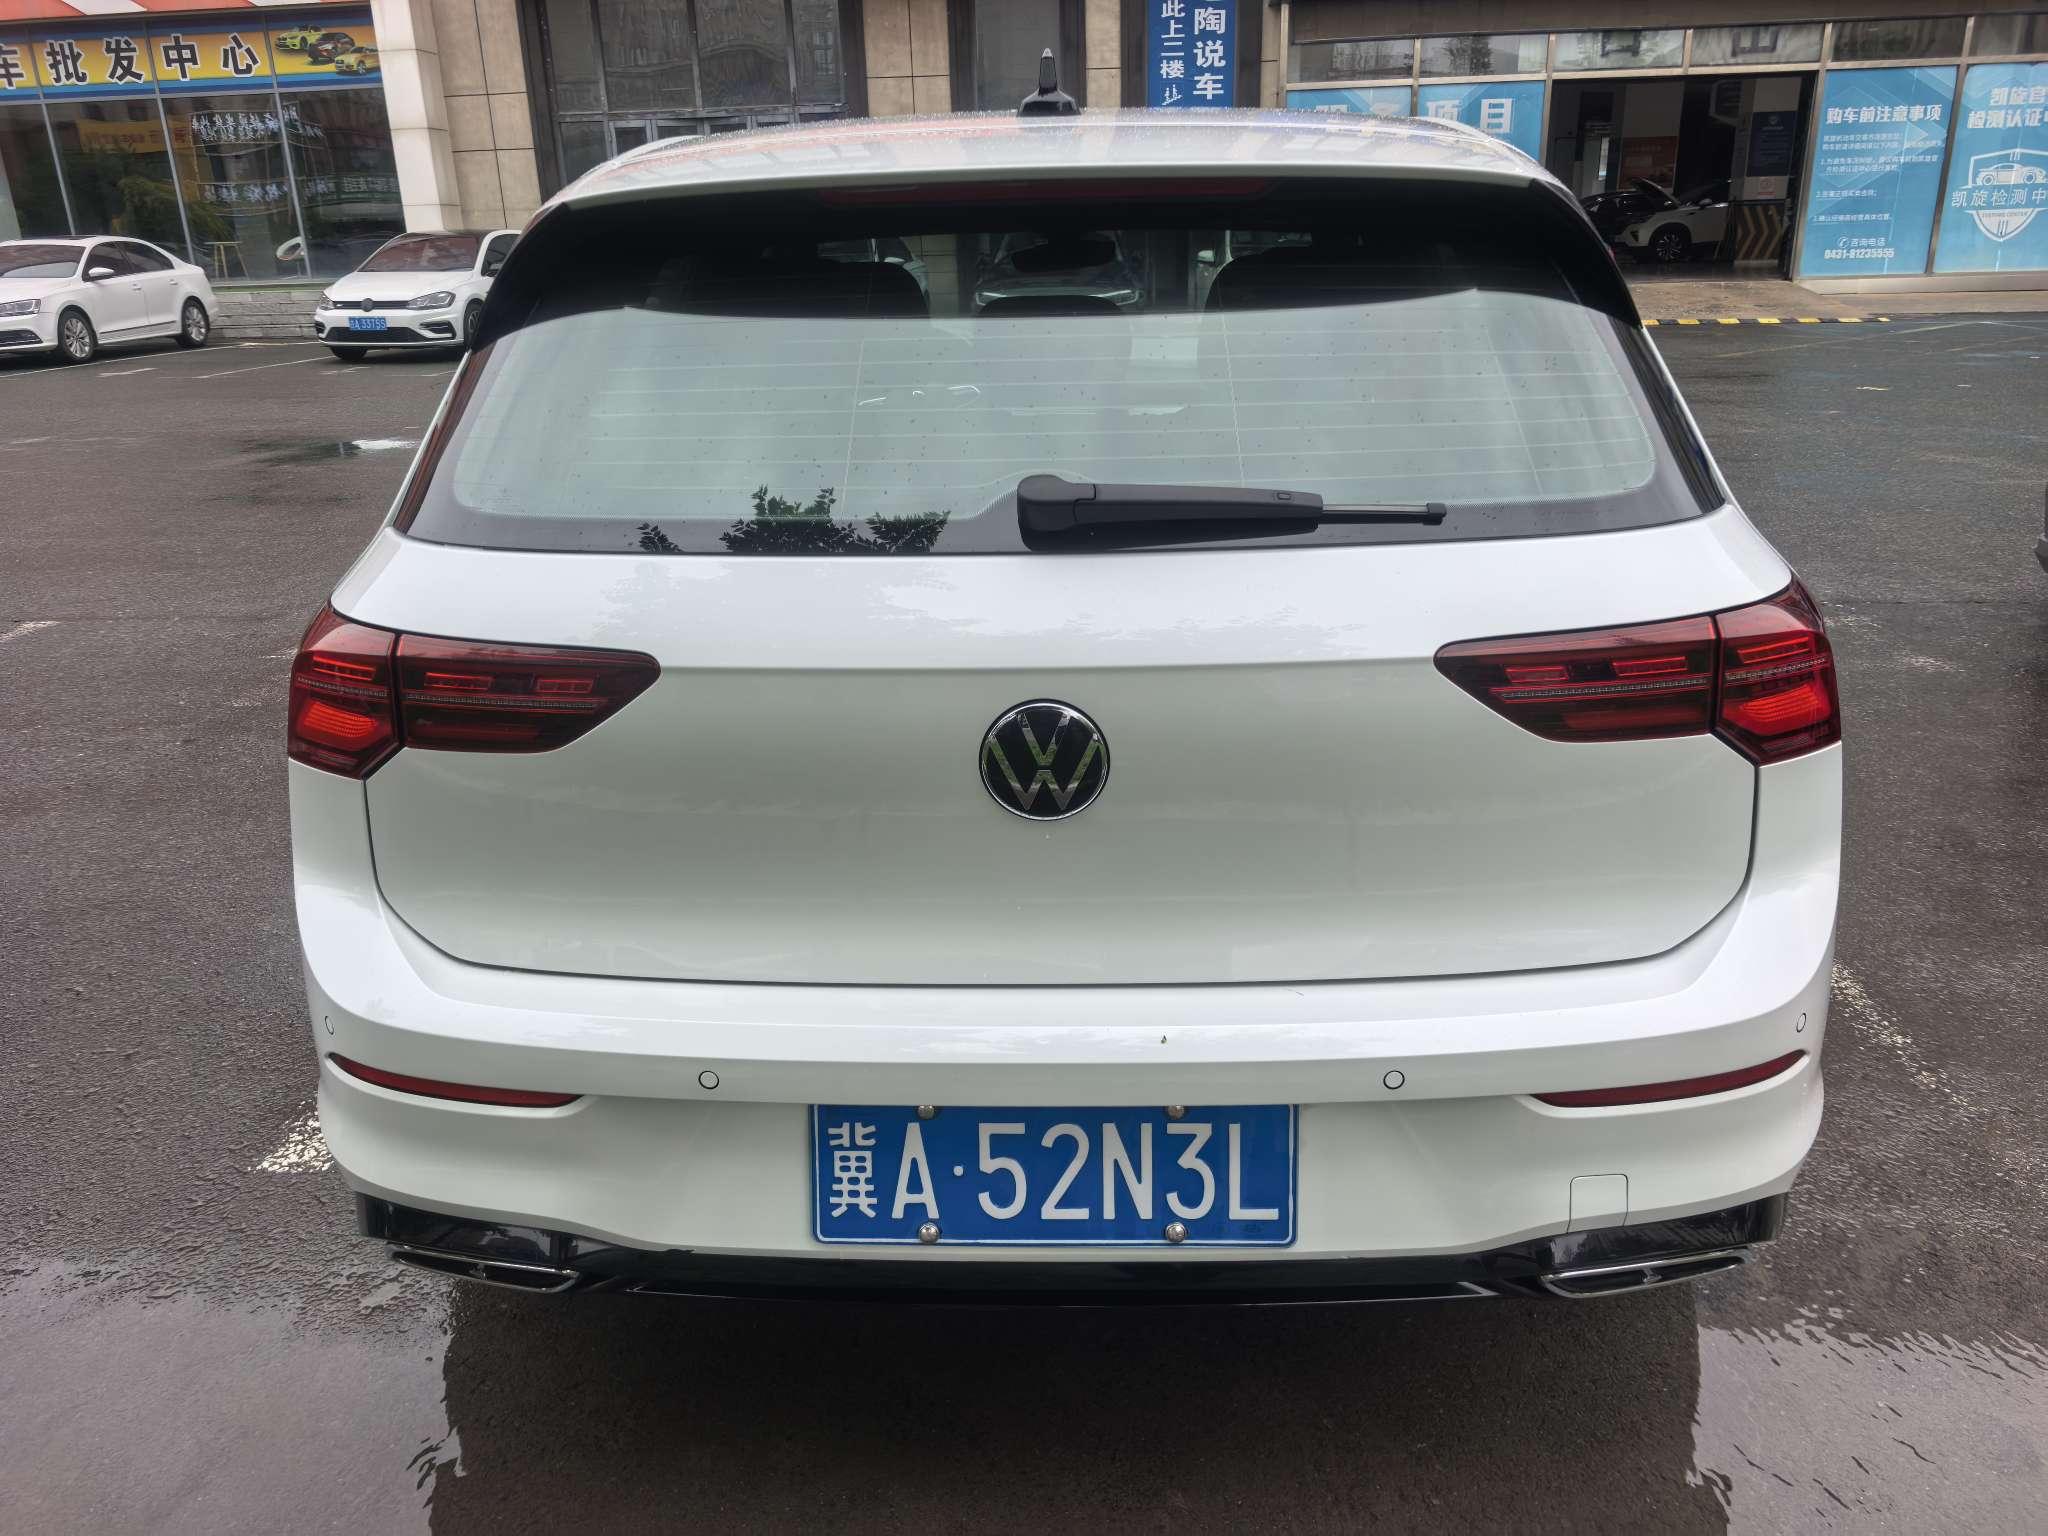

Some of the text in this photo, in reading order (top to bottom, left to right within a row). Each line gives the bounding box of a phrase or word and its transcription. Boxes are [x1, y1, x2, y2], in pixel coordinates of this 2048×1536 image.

[1192, 6, 1227, 101] 陶说车
[1826, 104, 1942, 125] 购车前注意事项
[1967, 108, 2048, 129] 检测认证
[1951, 187, 2047, 208] 凯旋检测中
